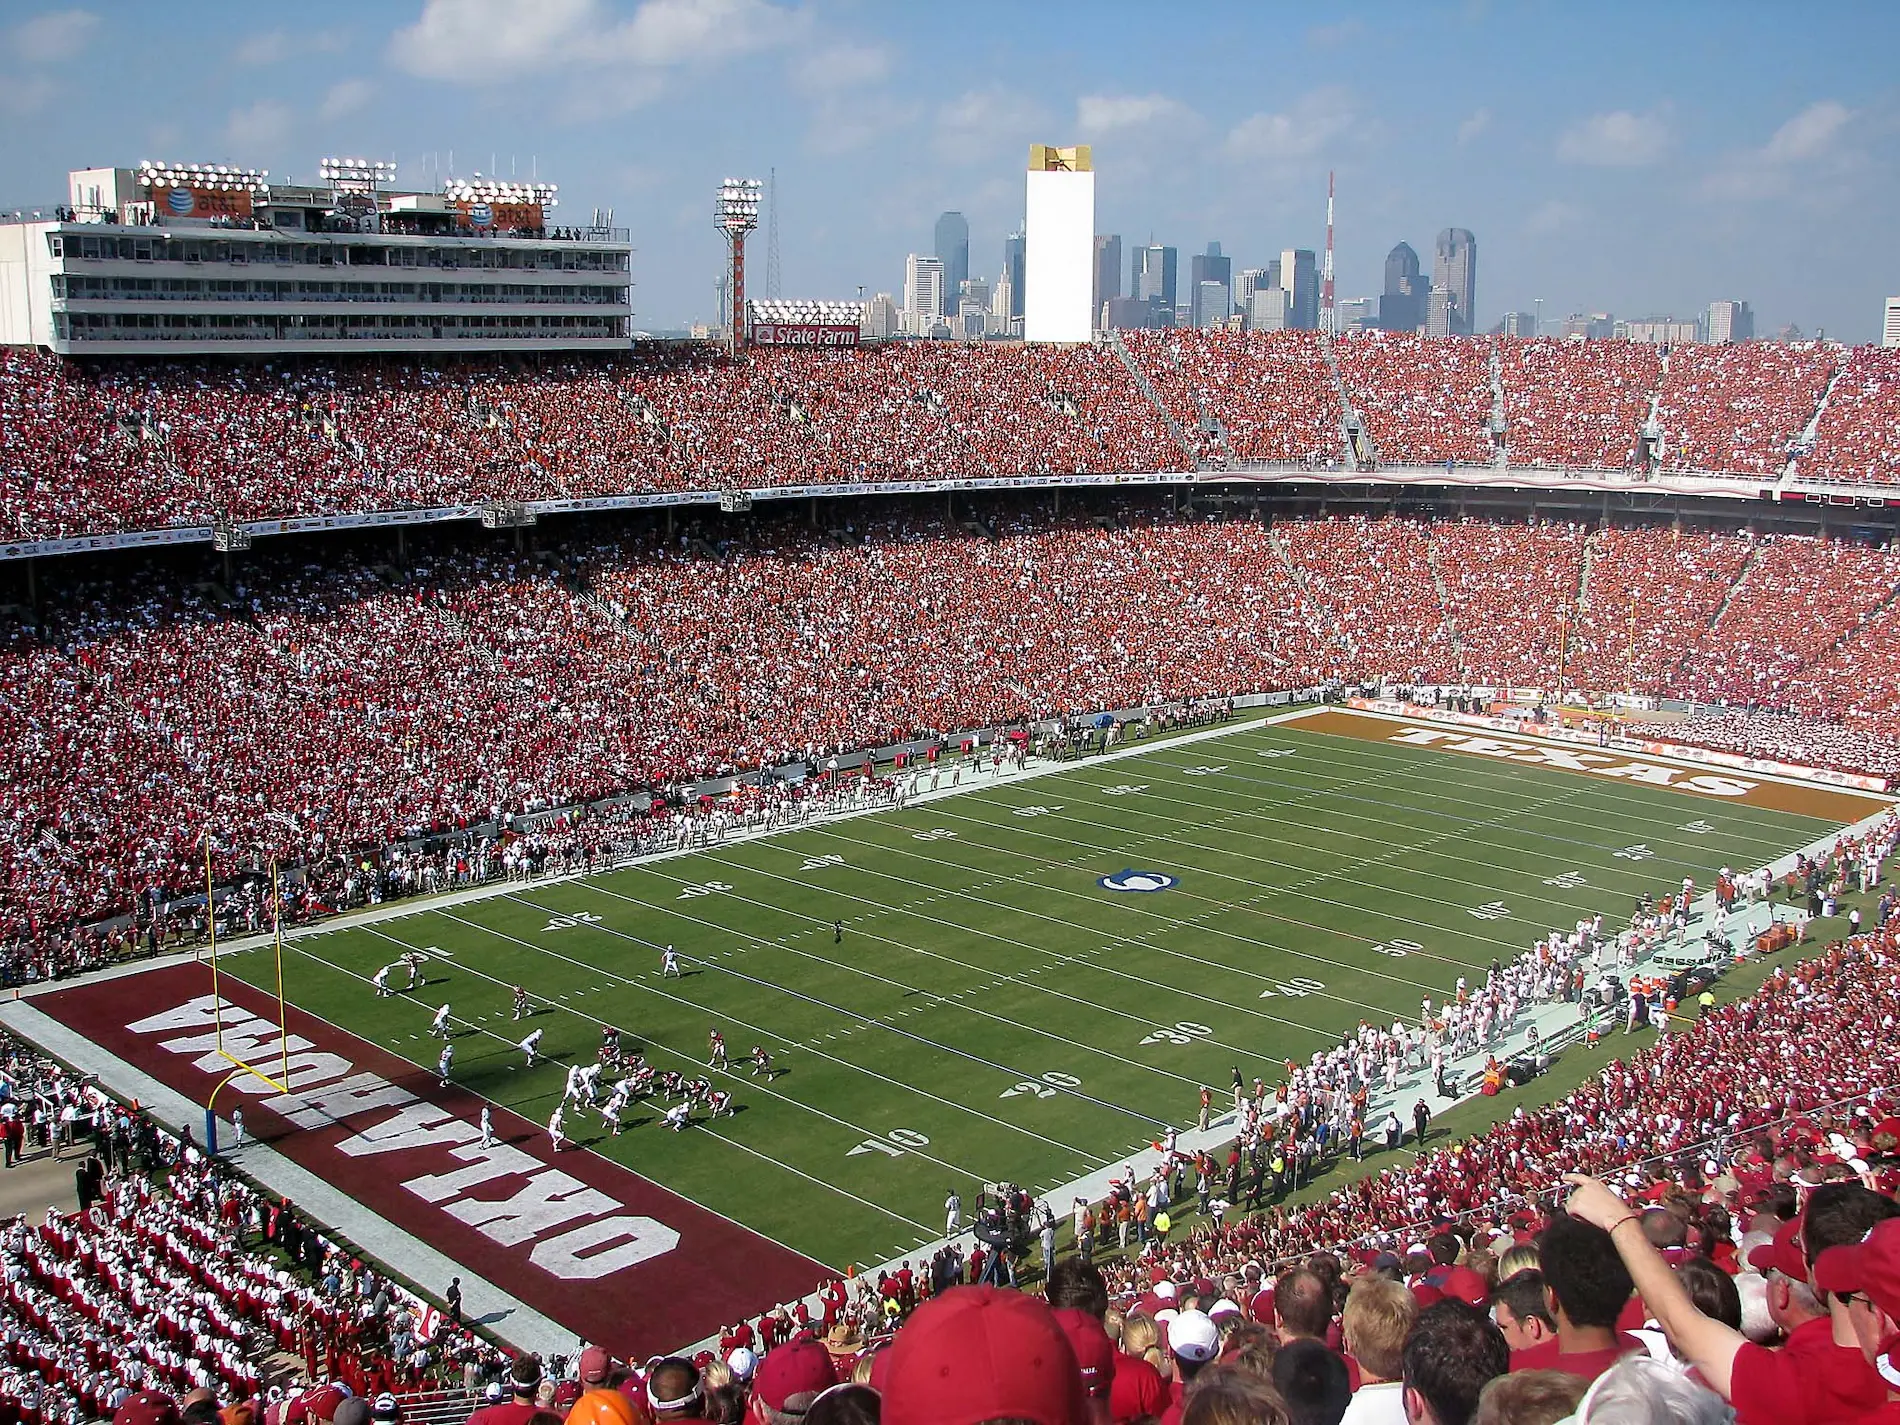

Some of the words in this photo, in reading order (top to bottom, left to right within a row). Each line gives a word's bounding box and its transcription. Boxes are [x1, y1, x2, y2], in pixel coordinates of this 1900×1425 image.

[199, 194, 236, 212] at&t
[497, 208, 530, 223] at&t
[1387, 727, 1760, 797] TEXAS
[1371, 939, 1424, 957] 50
[1274, 977, 1326, 997] 40
[1152, 1021, 1213, 1045] 30
[1014, 1071, 1082, 1099] 20
[125, 993, 682, 1280] OKLAHOMA
[861, 1128, 930, 1157] 10
